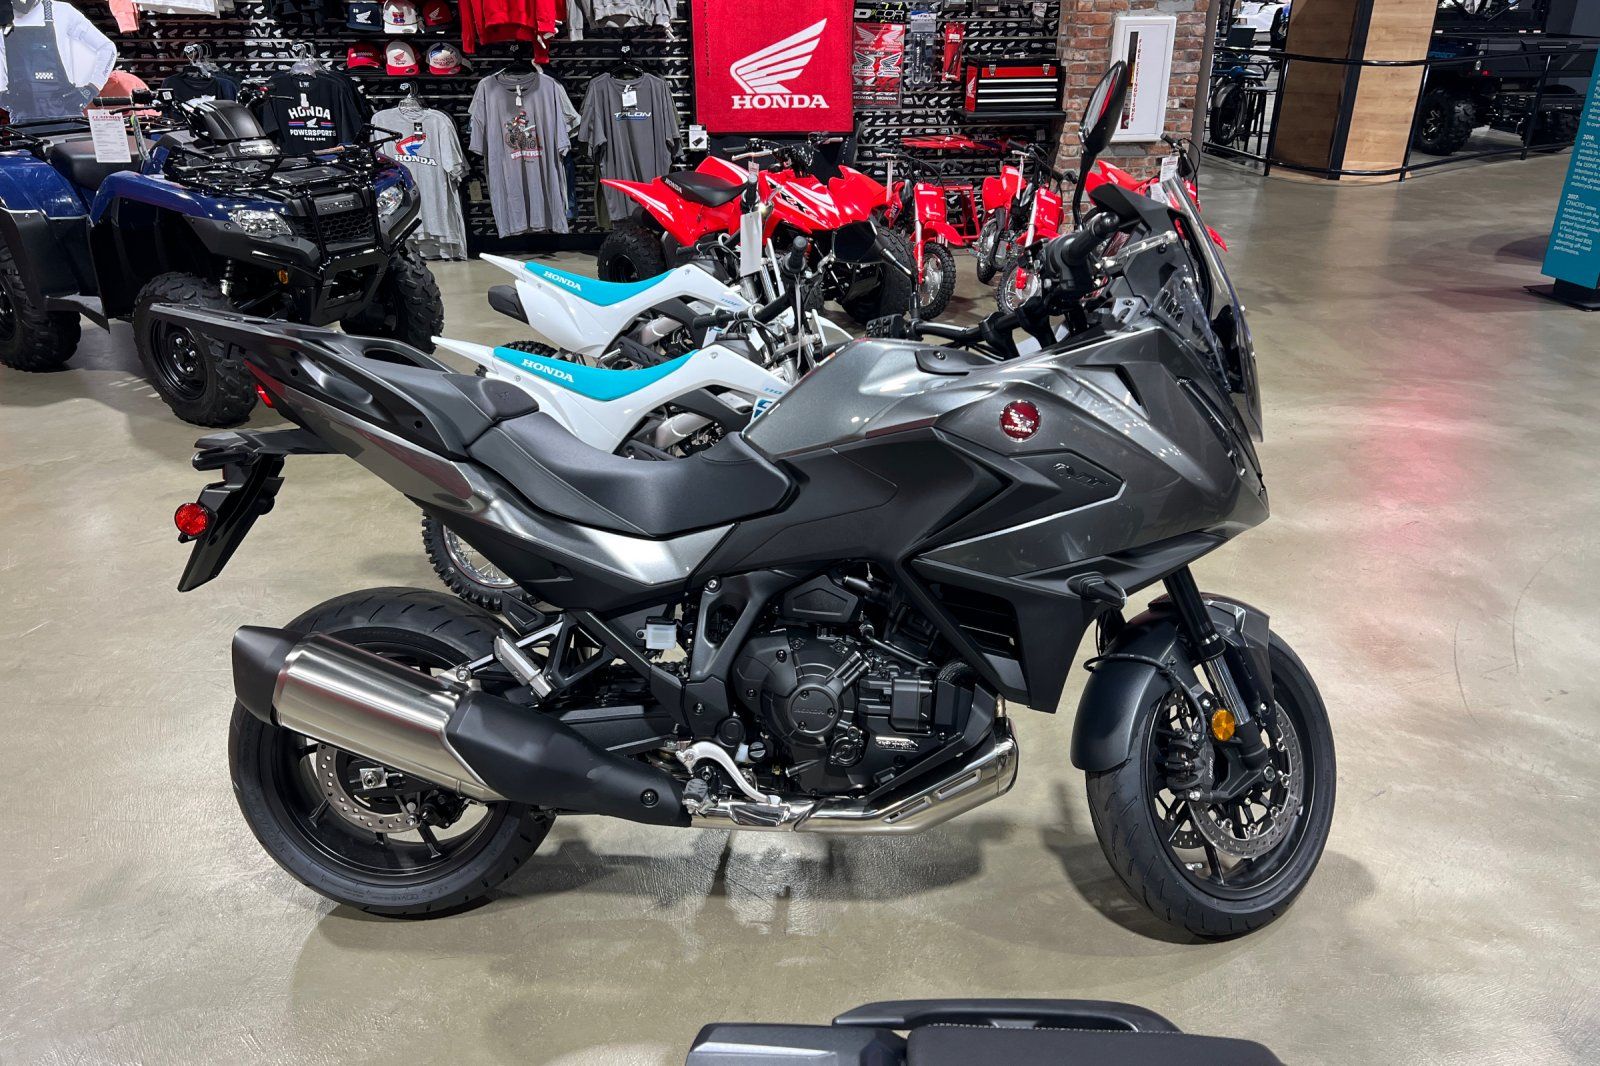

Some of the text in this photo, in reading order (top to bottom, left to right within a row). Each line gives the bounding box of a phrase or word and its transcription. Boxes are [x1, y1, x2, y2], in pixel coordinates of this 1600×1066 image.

[730, 94, 830, 109] HONDA
[288, 105, 331, 120] HONDA
[290, 129, 336, 137] POWERSPORTS
[394, 154, 438, 166] HONDA
[664, 177, 683, 194] HONDA
[543, 270, 582, 292] HONDA
[521, 358, 575, 383] HONDA
[1003, 424, 1033, 434] HONDA
